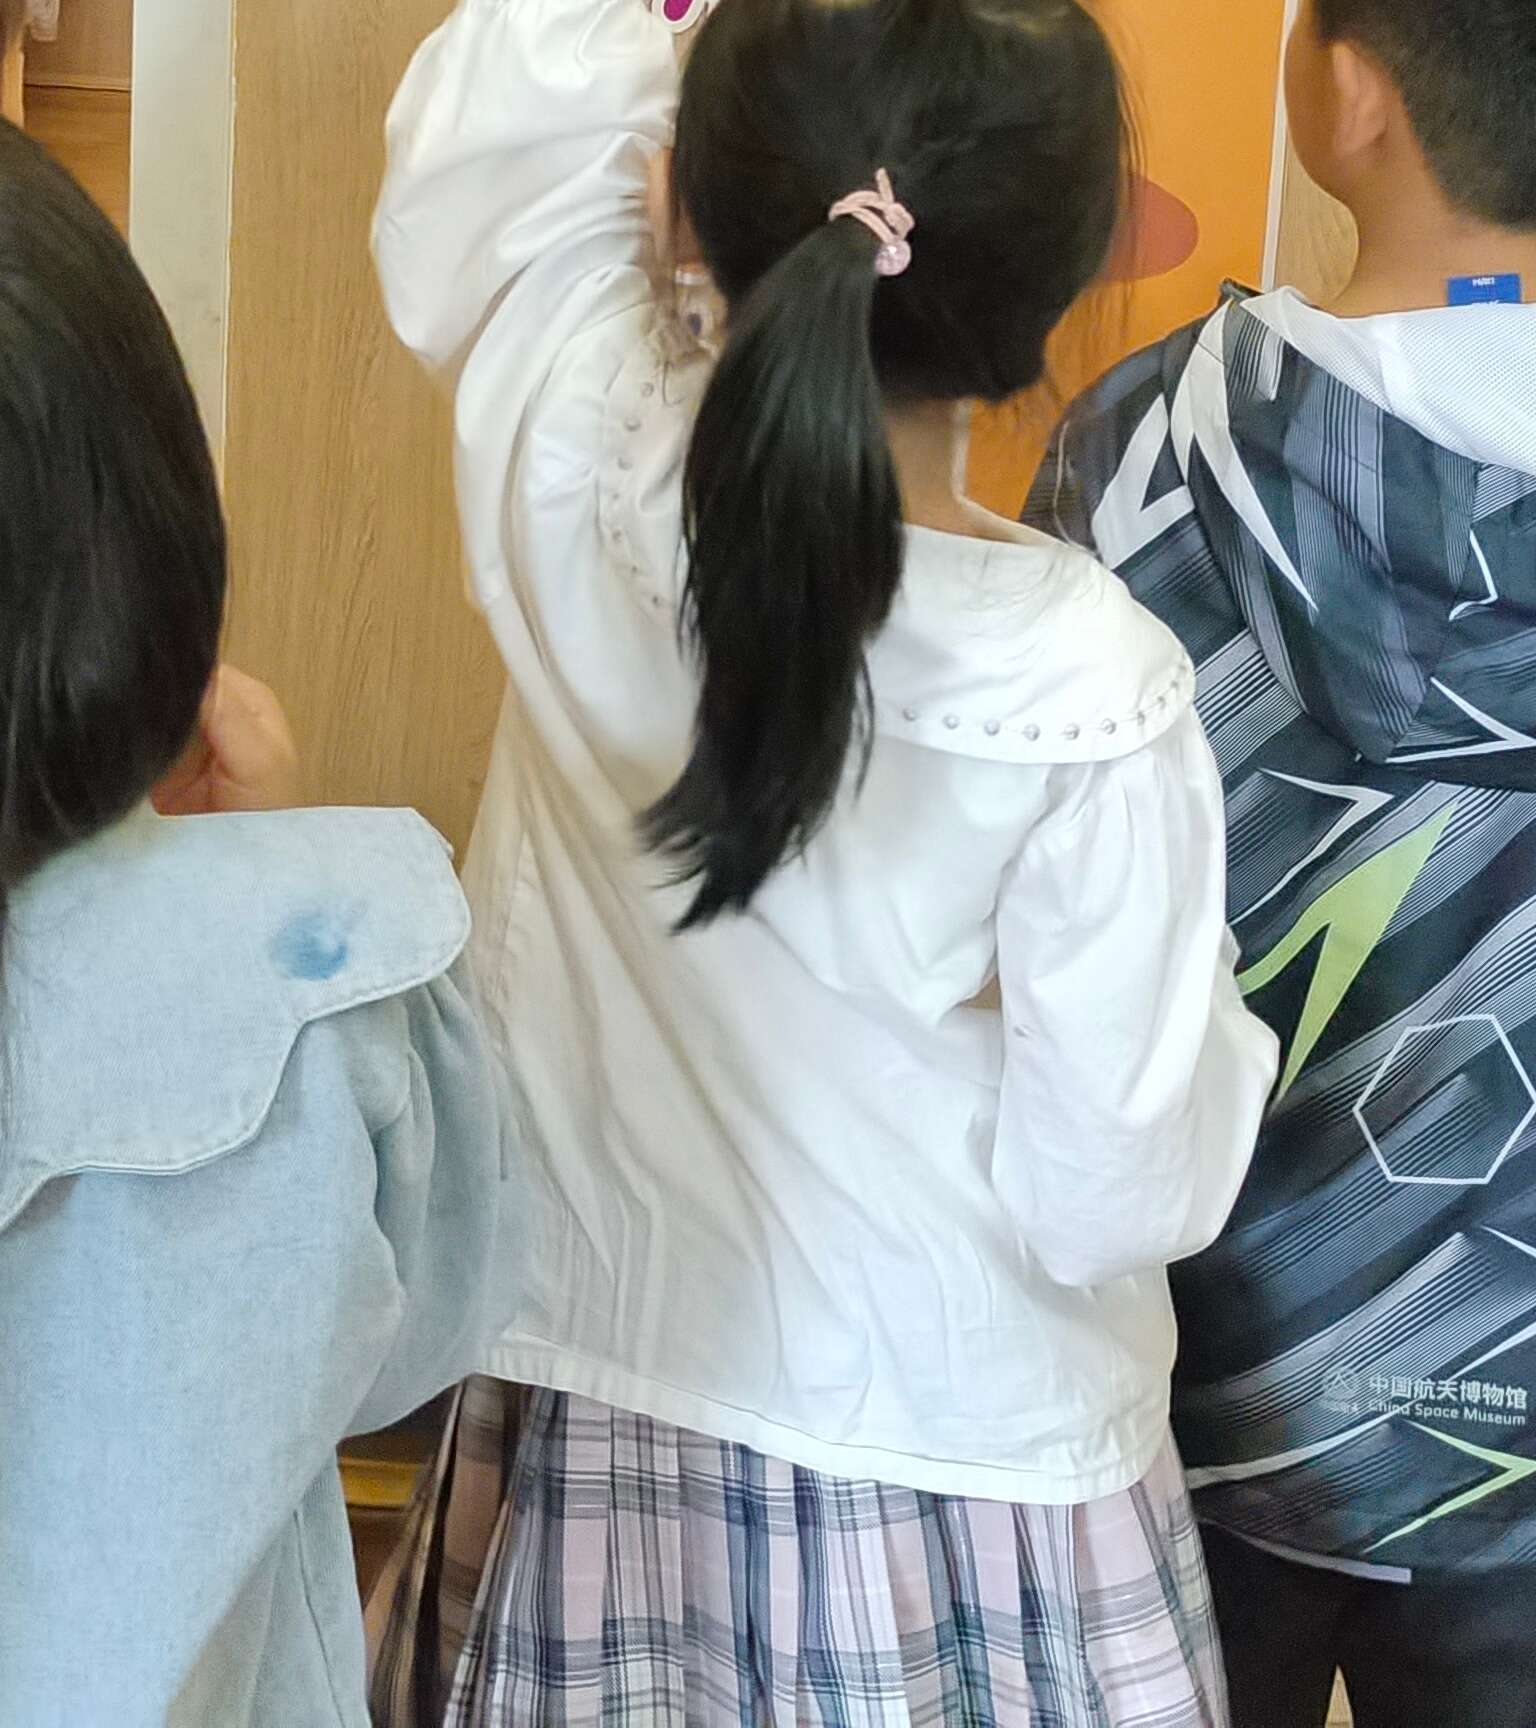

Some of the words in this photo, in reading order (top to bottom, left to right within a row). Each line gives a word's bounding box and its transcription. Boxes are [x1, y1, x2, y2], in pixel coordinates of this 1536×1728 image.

[1369, 1373, 1528, 1410] 中国航天博物馆
[1415, 1403, 1459, 1420] Space
[1463, 1408, 1526, 1426] Museum
